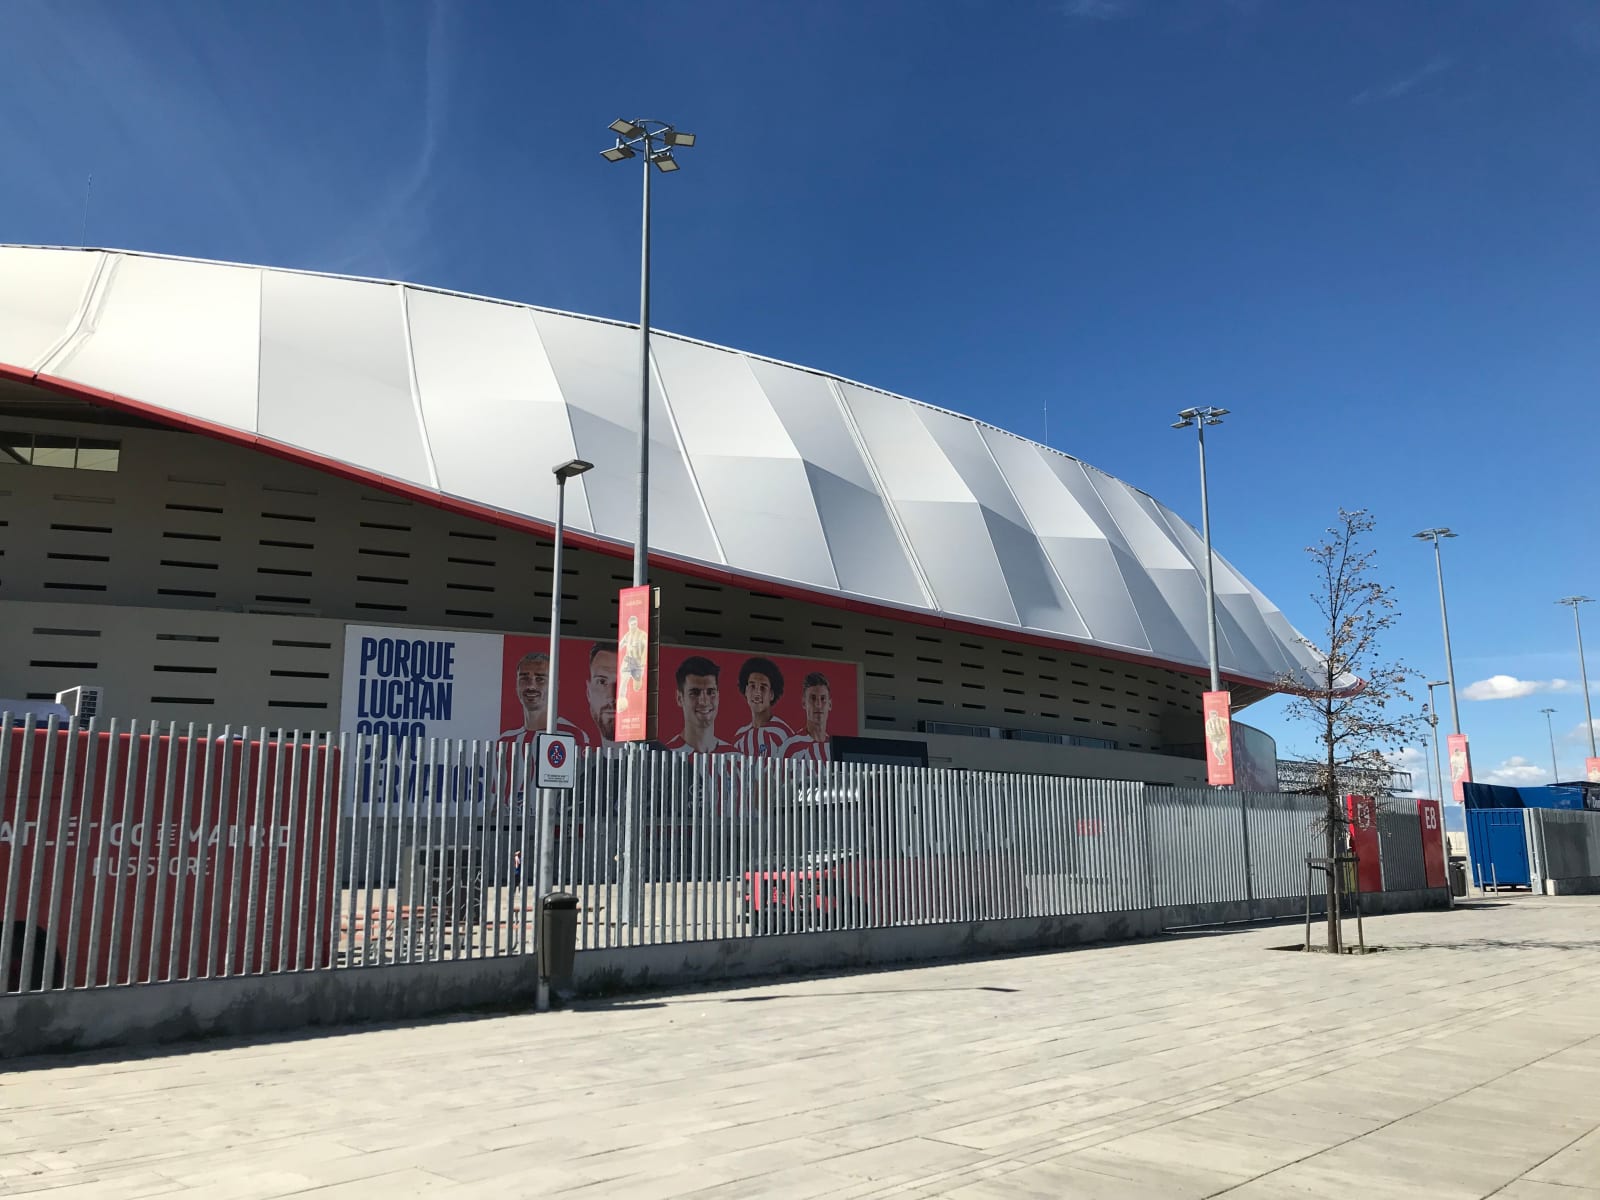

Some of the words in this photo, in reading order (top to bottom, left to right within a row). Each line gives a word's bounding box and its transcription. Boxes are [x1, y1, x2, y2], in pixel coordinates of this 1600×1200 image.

[360, 637, 455, 683] PORQUE
[357, 679, 453, 721] LUCHAN
[356, 720, 427, 762] COMO
[0, 816, 150, 847] ATÉTCO
[188, 824, 294, 847] MADRD
[1424, 806, 1437, 830] E8
[147, 856, 211, 877] SORE
